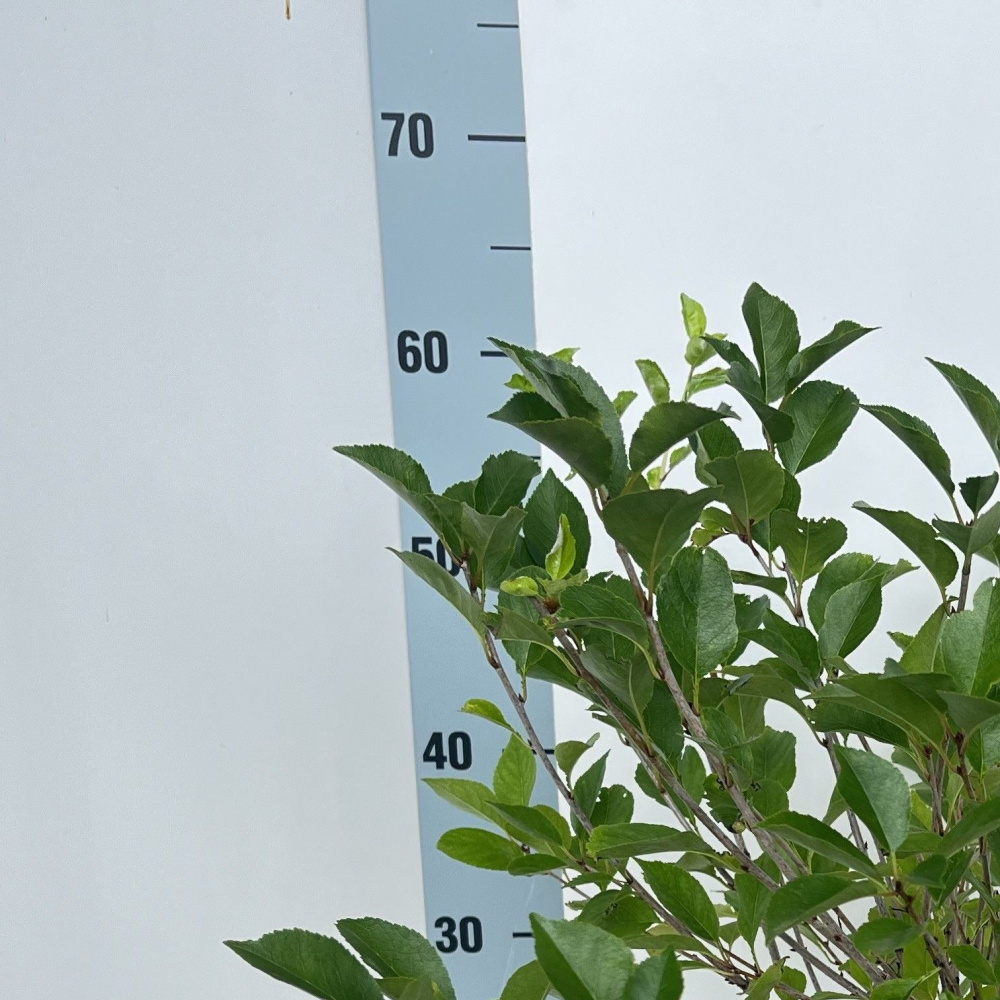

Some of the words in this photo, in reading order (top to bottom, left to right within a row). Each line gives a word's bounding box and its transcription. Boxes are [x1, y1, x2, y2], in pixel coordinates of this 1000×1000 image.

[380, 112, 434, 159] 70
[397, 329, 449, 374] 60
[422, 731, 473, 771] 40
[434, 915, 484, 954] 30
